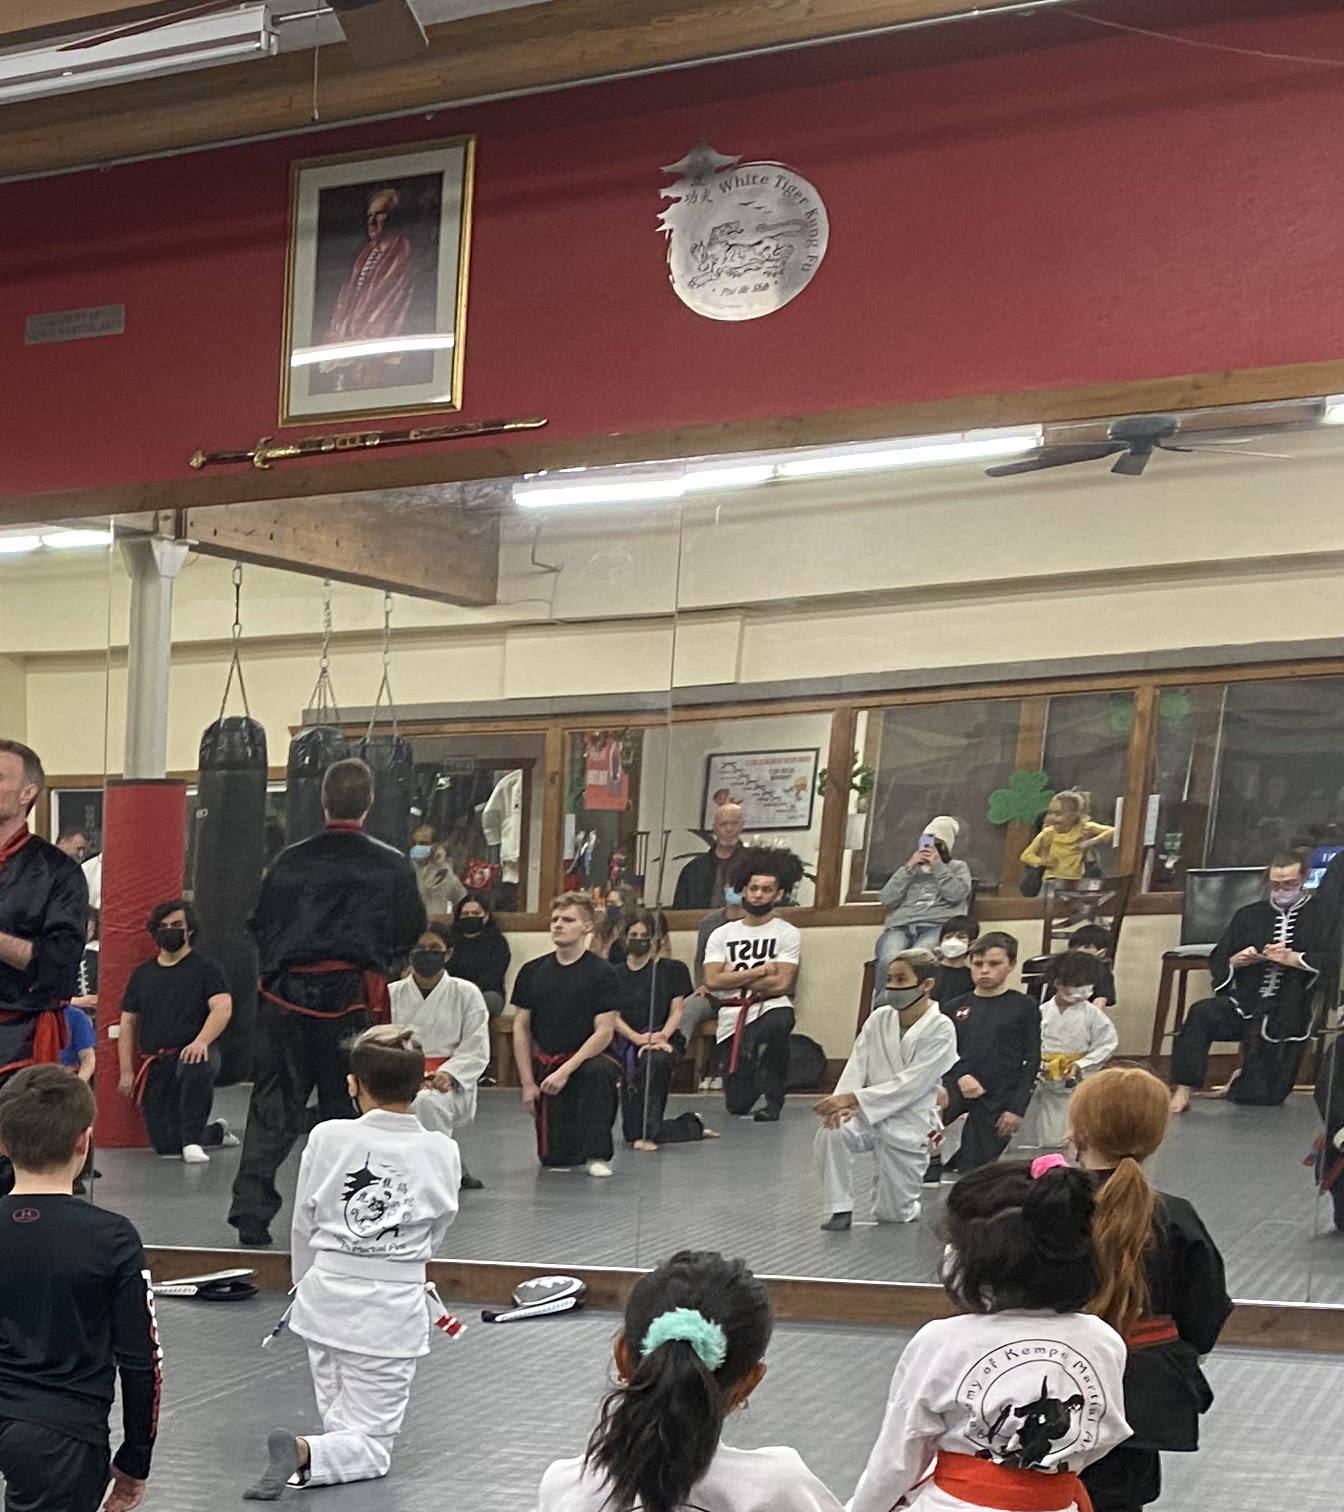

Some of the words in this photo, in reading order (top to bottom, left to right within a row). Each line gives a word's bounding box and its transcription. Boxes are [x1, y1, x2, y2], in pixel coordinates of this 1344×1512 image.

[718, 173, 769, 194] White
[774, 174, 810, 205] Tiger
[804, 207, 819, 249] Kung
[800, 254, 819, 272] Fu
[983, 1357, 998, 1375] of
[1072, 1360, 1102, 1422] Martial
